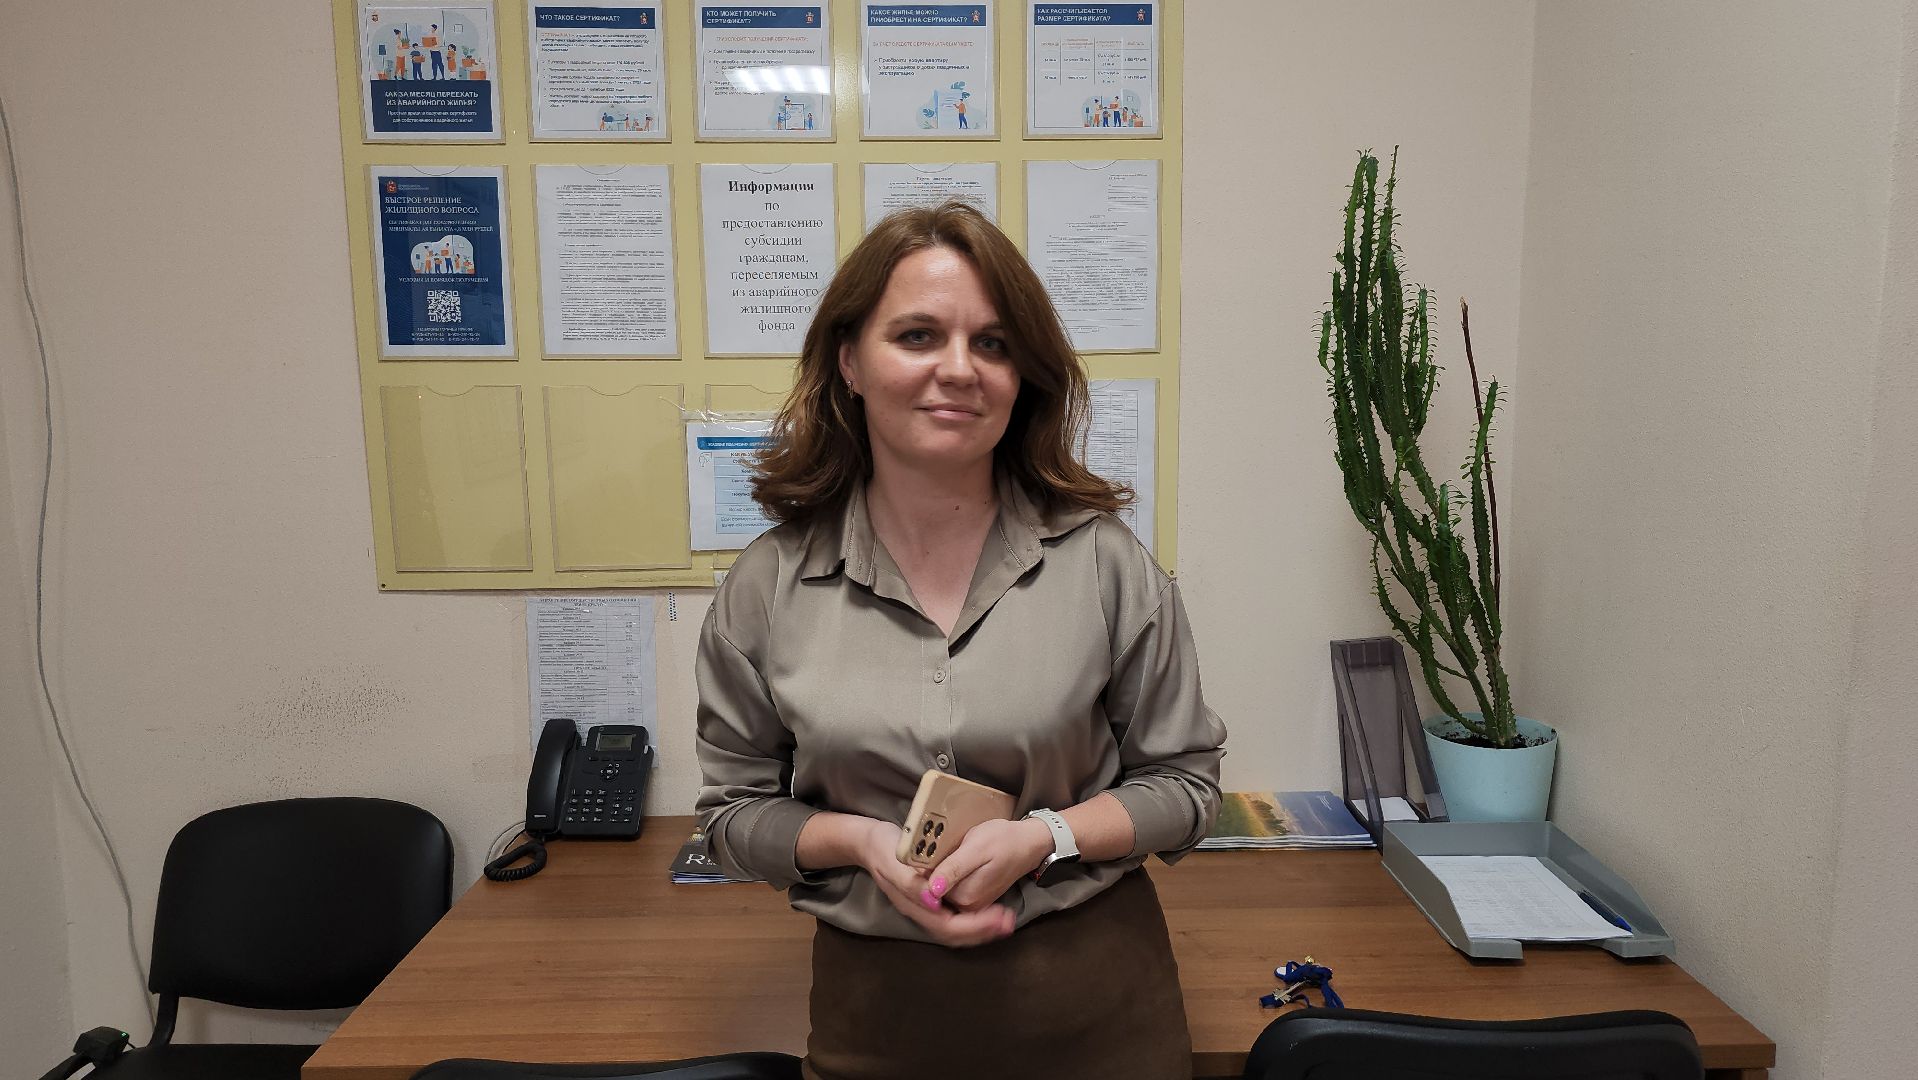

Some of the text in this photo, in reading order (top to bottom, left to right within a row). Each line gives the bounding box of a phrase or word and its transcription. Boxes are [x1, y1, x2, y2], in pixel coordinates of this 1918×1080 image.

[575, 14, 621, 22] СЕРТИФИКАТ?
[409, 91, 436, 99] МЕСЯЦ
[728, 180, 814, 195] Информация
[384, 196, 462, 204] БЫСТРОЕ РЕШЕНИЕ
[764, 201, 780, 211] по
[384, 205, 480, 214] ЖИЛИЩНОГО ВОПРОСА
[721, 219, 824, 232] предоставлению
[744, 234, 803, 249] субсидии
[739, 254, 809, 266] гражданам,
[730, 270, 819, 283] переселяемым
[732, 285, 819, 299] из аварийного
[740, 304, 812, 315] жилищного
[758, 319, 796, 334] фонда
